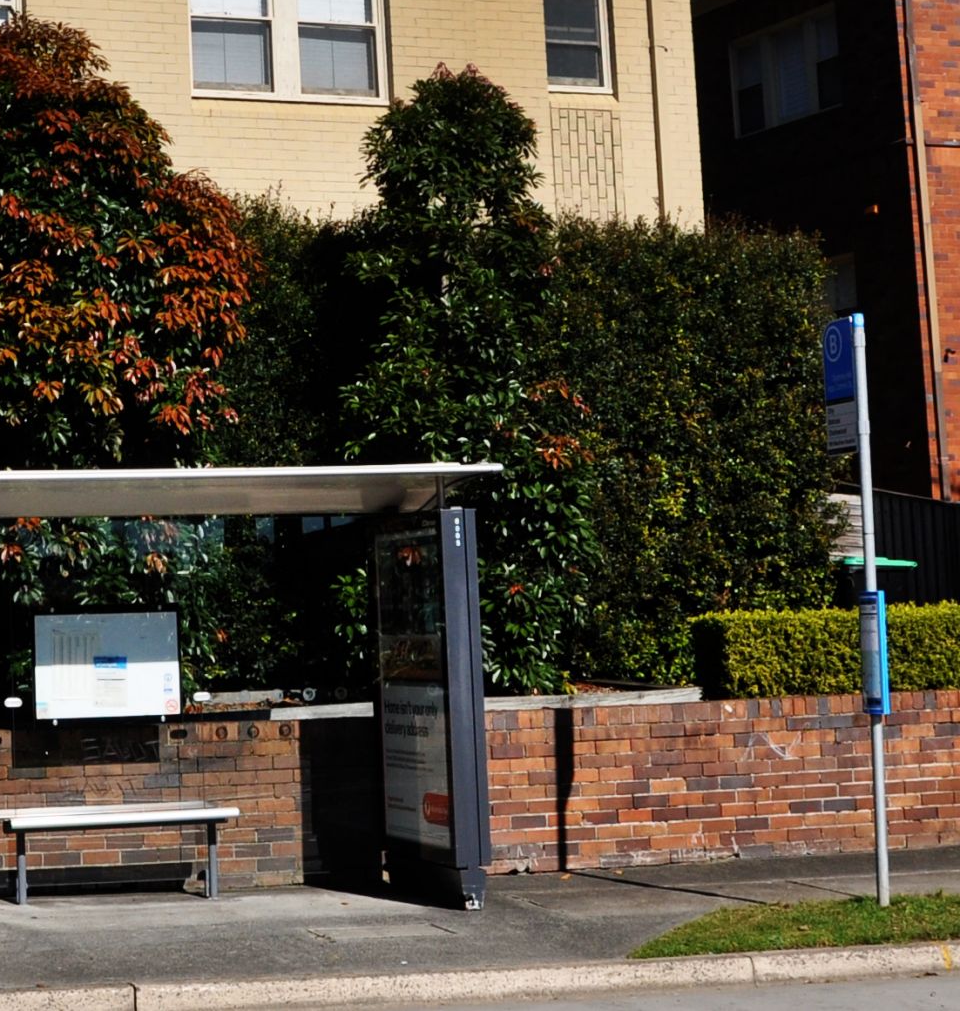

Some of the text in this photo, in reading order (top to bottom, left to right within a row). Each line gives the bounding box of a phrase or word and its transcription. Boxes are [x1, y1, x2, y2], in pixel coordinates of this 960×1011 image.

[830, 335, 838, 354] B
[384, 701, 400, 714] Home
[412, 703, 425, 718] your
[425, 701, 438, 719] only
[385, 719, 429, 738] delivery address
